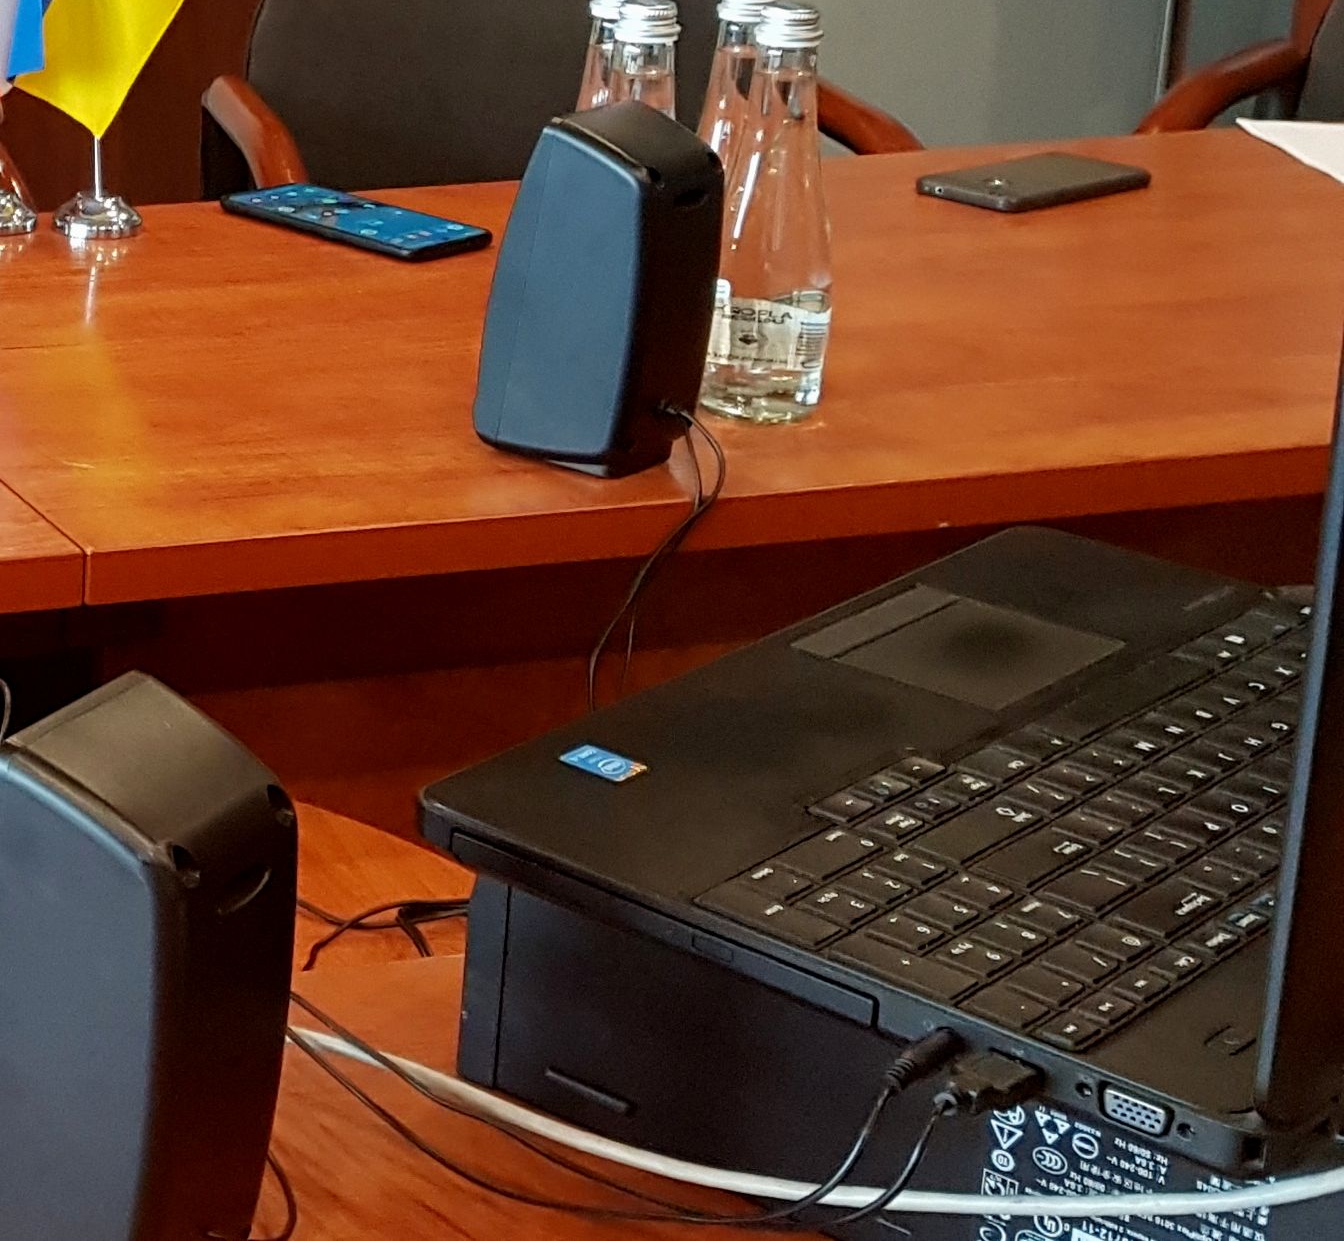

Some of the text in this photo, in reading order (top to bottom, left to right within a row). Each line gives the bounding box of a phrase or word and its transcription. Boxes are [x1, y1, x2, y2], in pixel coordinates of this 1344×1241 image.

[1274, 665, 1293, 676] X
[1247, 681, 1266, 690] C
[1270, 722, 1289, 731] G
[1243, 736, 1263, 747] H
[1186, 768, 1206, 779] K
[884, 879, 901, 889] 2
[849, 899, 865, 909] 3
[916, 925, 931, 934] 6
